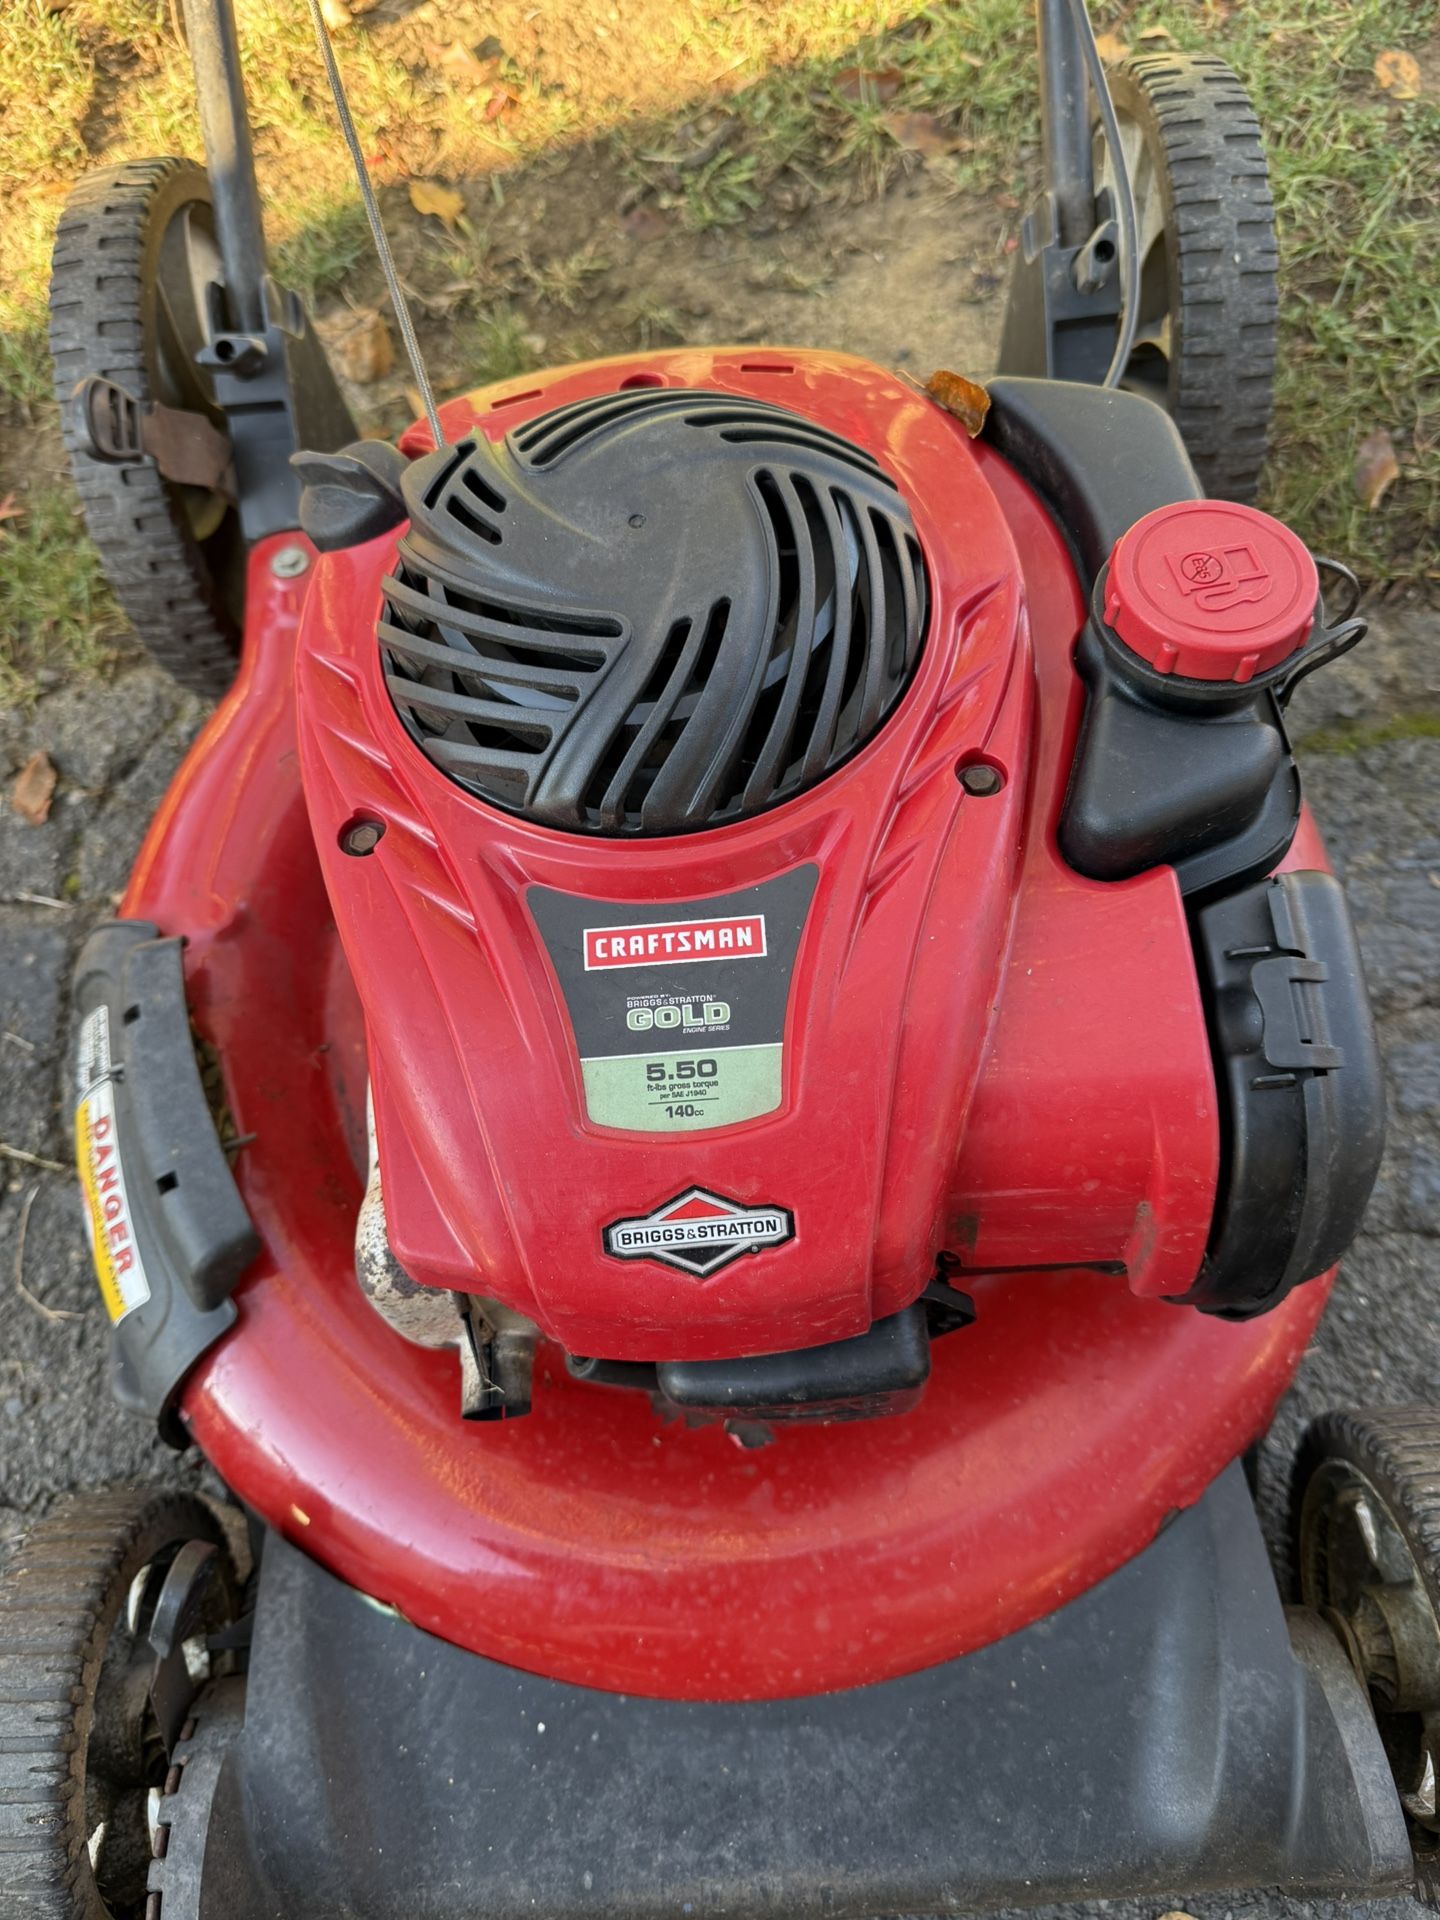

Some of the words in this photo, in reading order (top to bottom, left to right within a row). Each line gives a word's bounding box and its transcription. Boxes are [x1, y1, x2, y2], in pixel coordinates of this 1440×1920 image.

[595, 926, 753, 959] CRAFTSMAN
[626, 1001, 731, 1031] GOLD
[682, 1026, 707, 1034] ENGINE
[707, 1024, 731, 1032] SERIES
[646, 1058, 718, 1082] 5.50
[646, 1083, 667, 1092] ft-lbs
[668, 1081, 691, 1092] gross
[692, 1080, 719, 1089] torque
[659, 1092, 671, 1100] per
[671, 1090, 685, 1098] SAE
[685, 1089, 707, 1097] J1940
[665, 1104, 705, 1119] 140cc
[92, 1114, 136, 1275] DANGER
